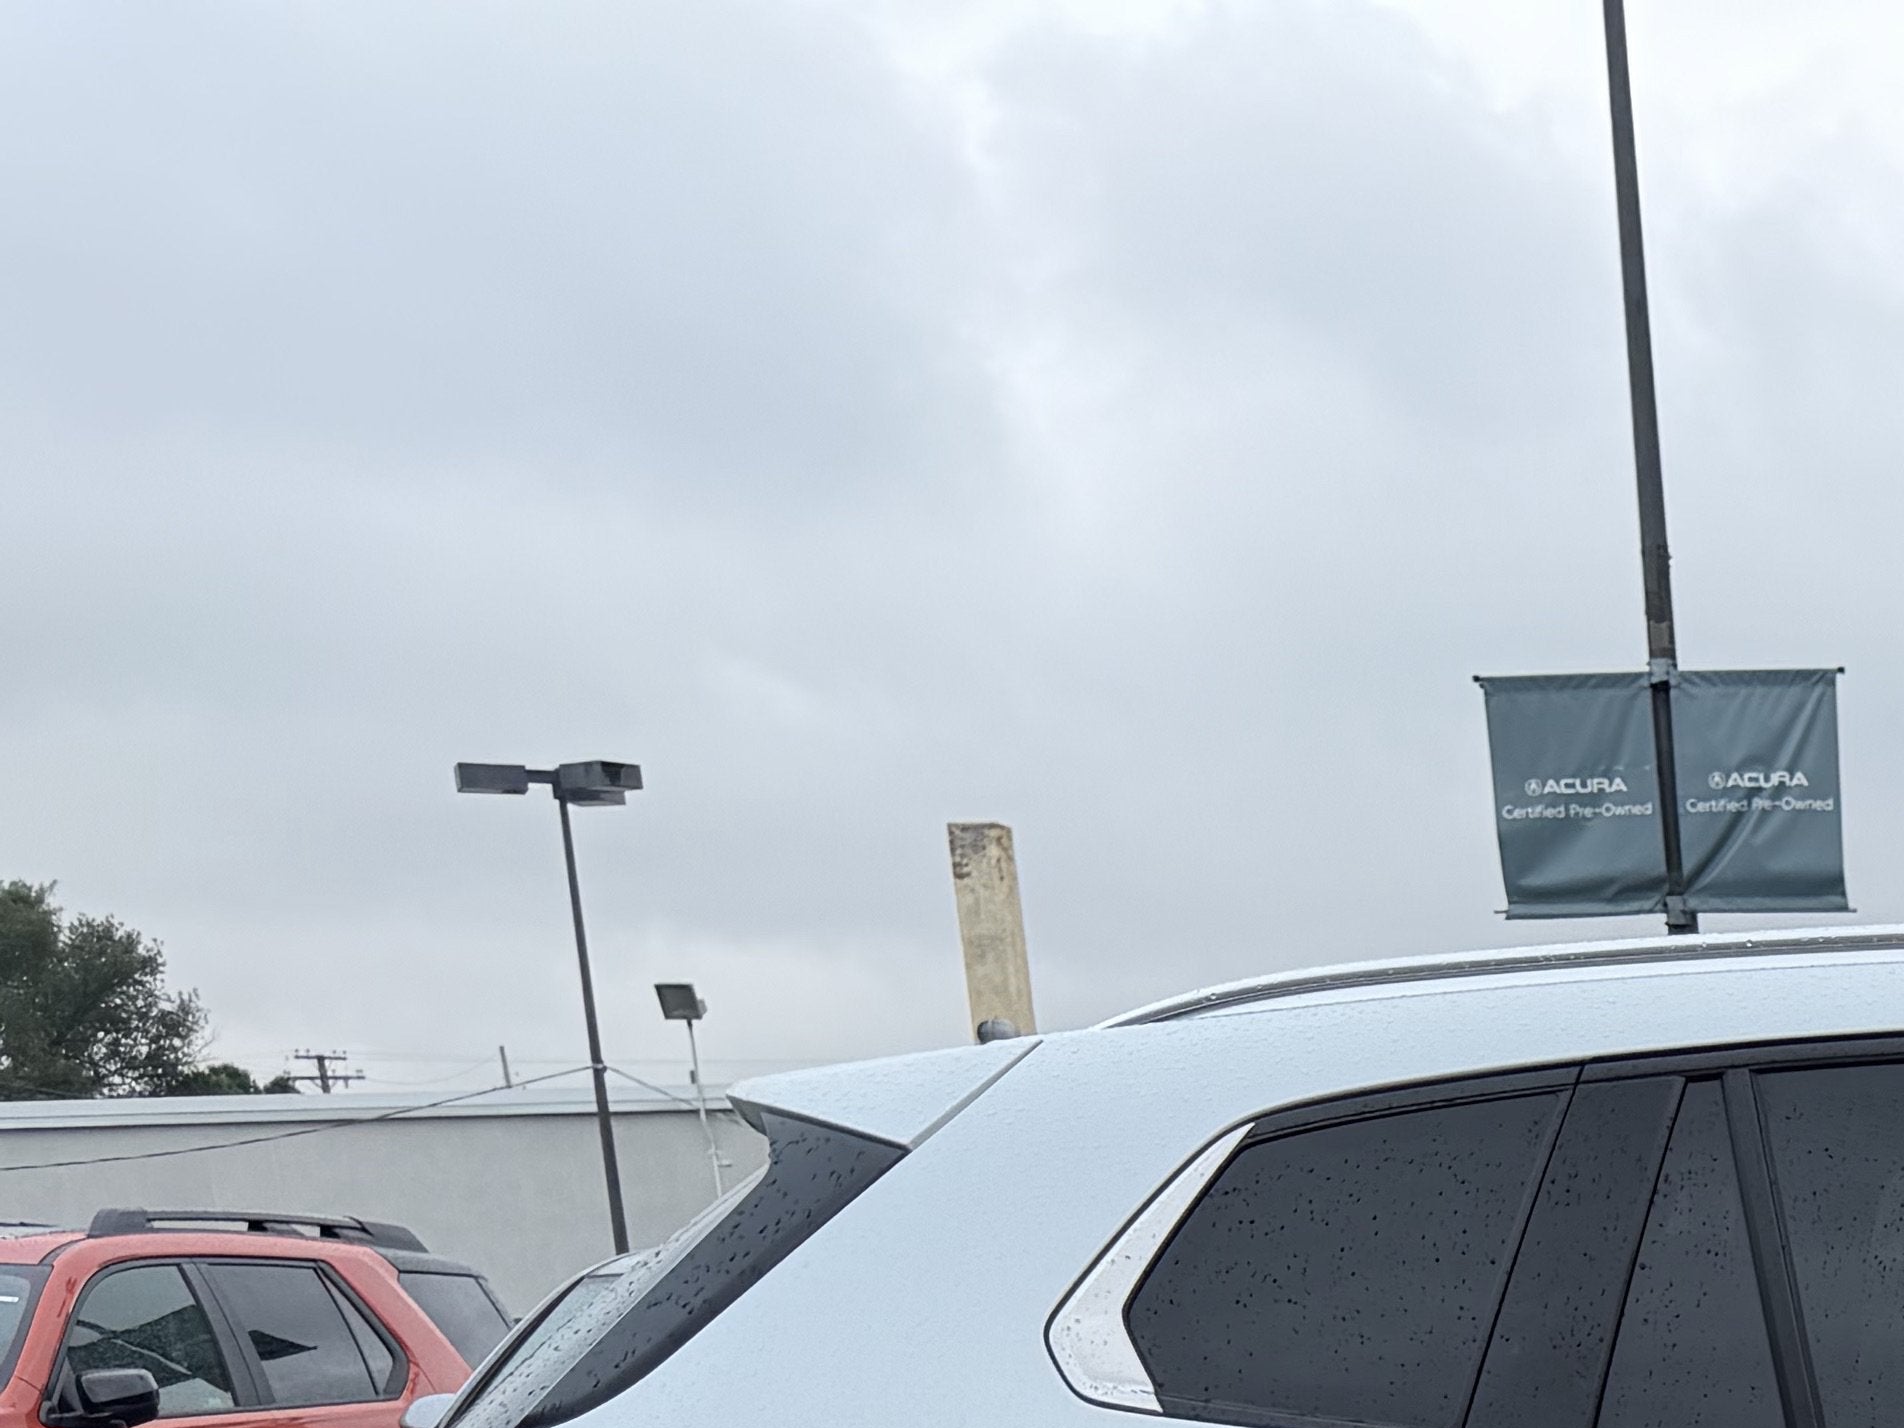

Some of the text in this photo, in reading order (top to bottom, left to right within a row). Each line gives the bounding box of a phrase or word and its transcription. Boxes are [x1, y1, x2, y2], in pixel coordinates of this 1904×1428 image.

[1543, 777, 1628, 795] ACURA
[1726, 771, 1809, 788] ACURA
[1502, 802, 1653, 820] Certified Pre-Owned
[1685, 796, 1834, 813] Certified Pre-Owned
